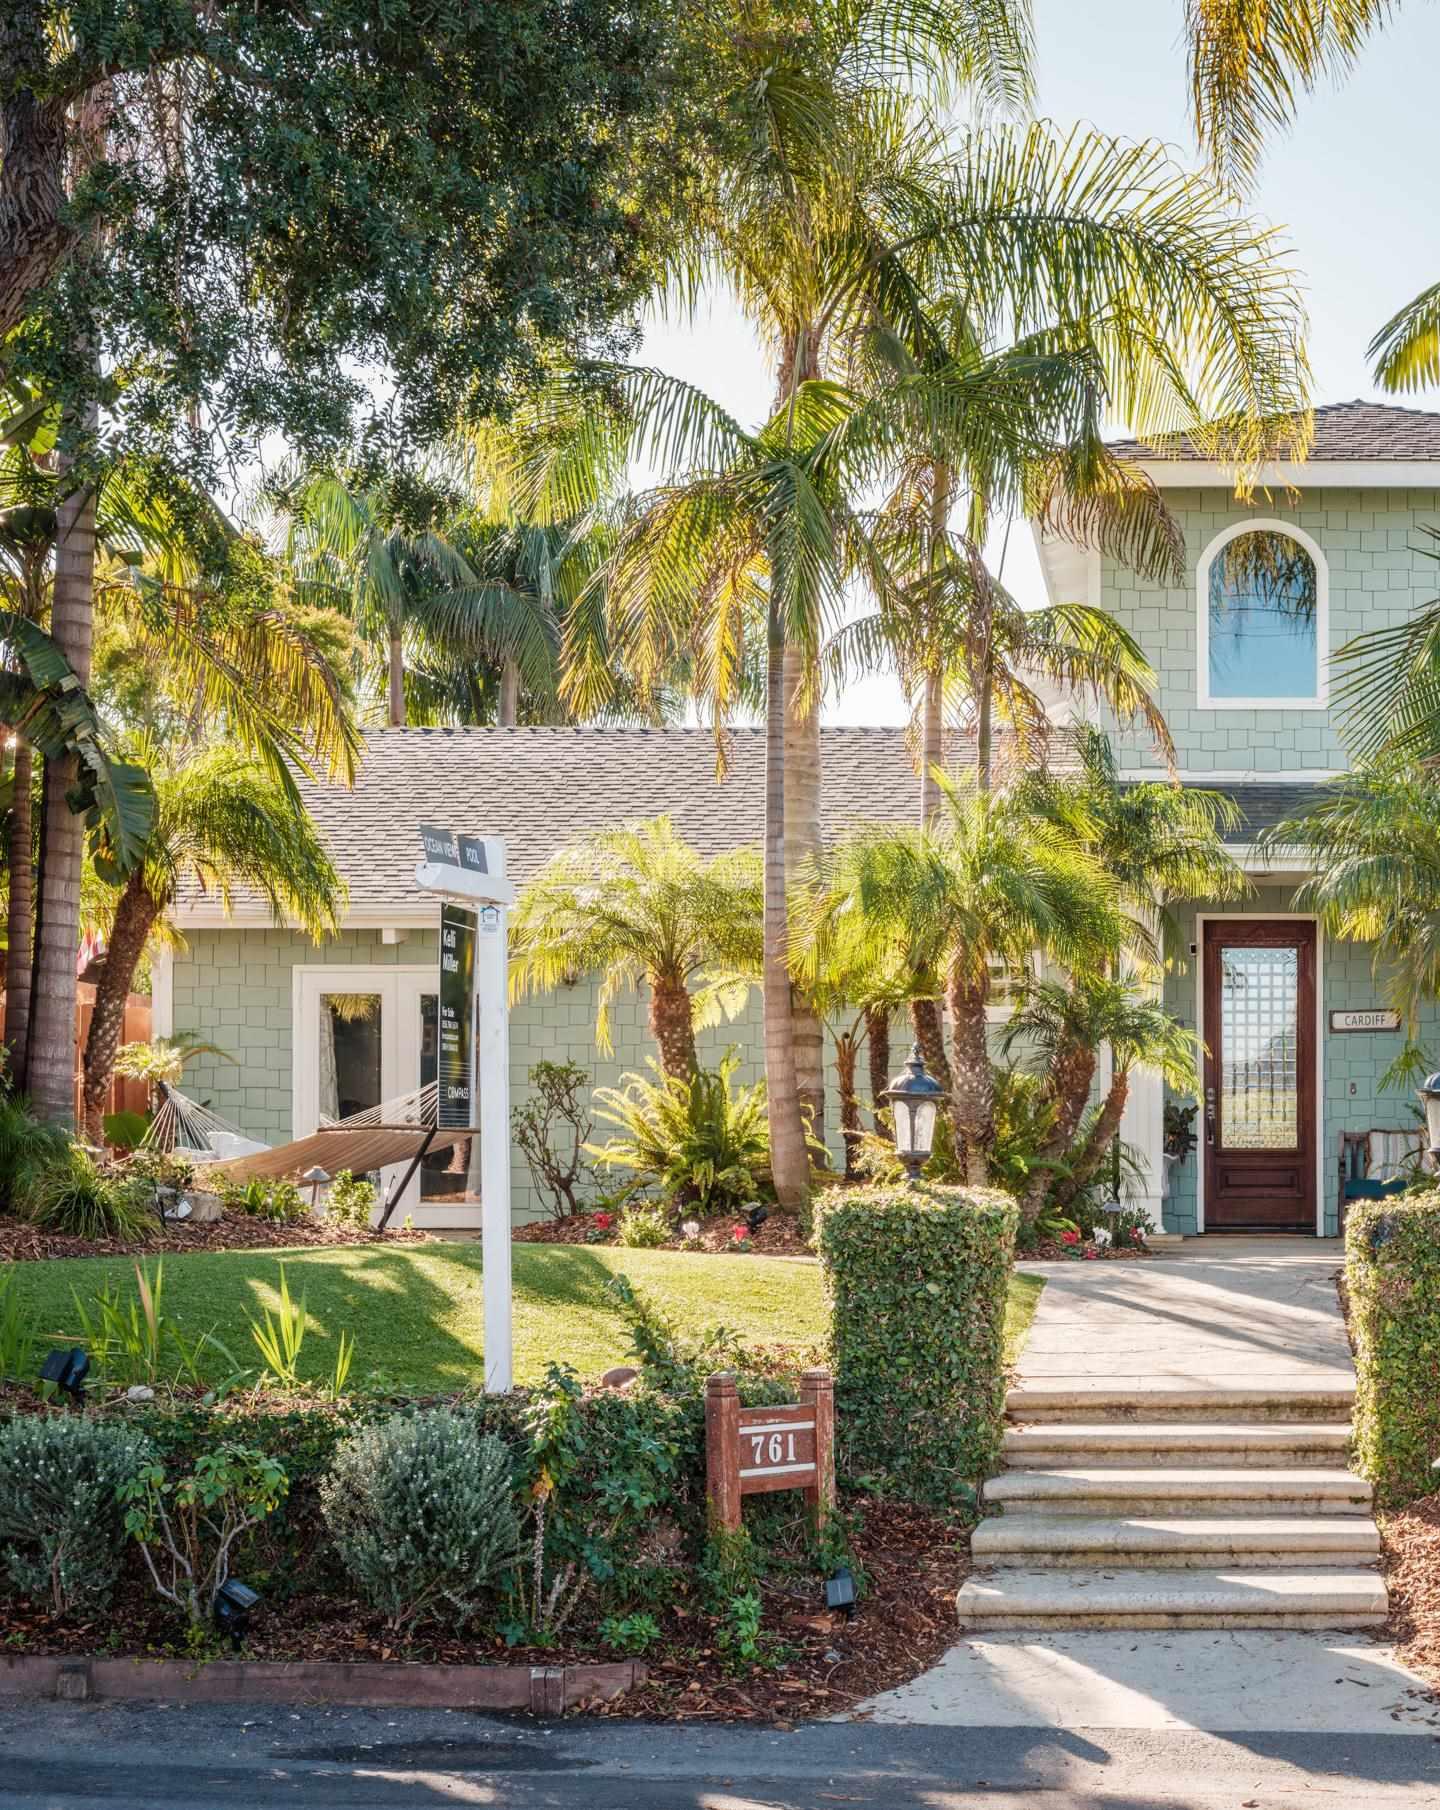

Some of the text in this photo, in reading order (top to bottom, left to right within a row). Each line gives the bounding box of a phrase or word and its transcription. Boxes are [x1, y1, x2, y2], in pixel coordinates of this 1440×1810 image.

[443, 928, 456, 948] Kelli
[443, 952, 459, 973] Miller
[1345, 1015, 1385, 1026] CARDIFF
[448, 1087, 469, 1099] COMPASS
[752, 1433, 796, 1464] 761
